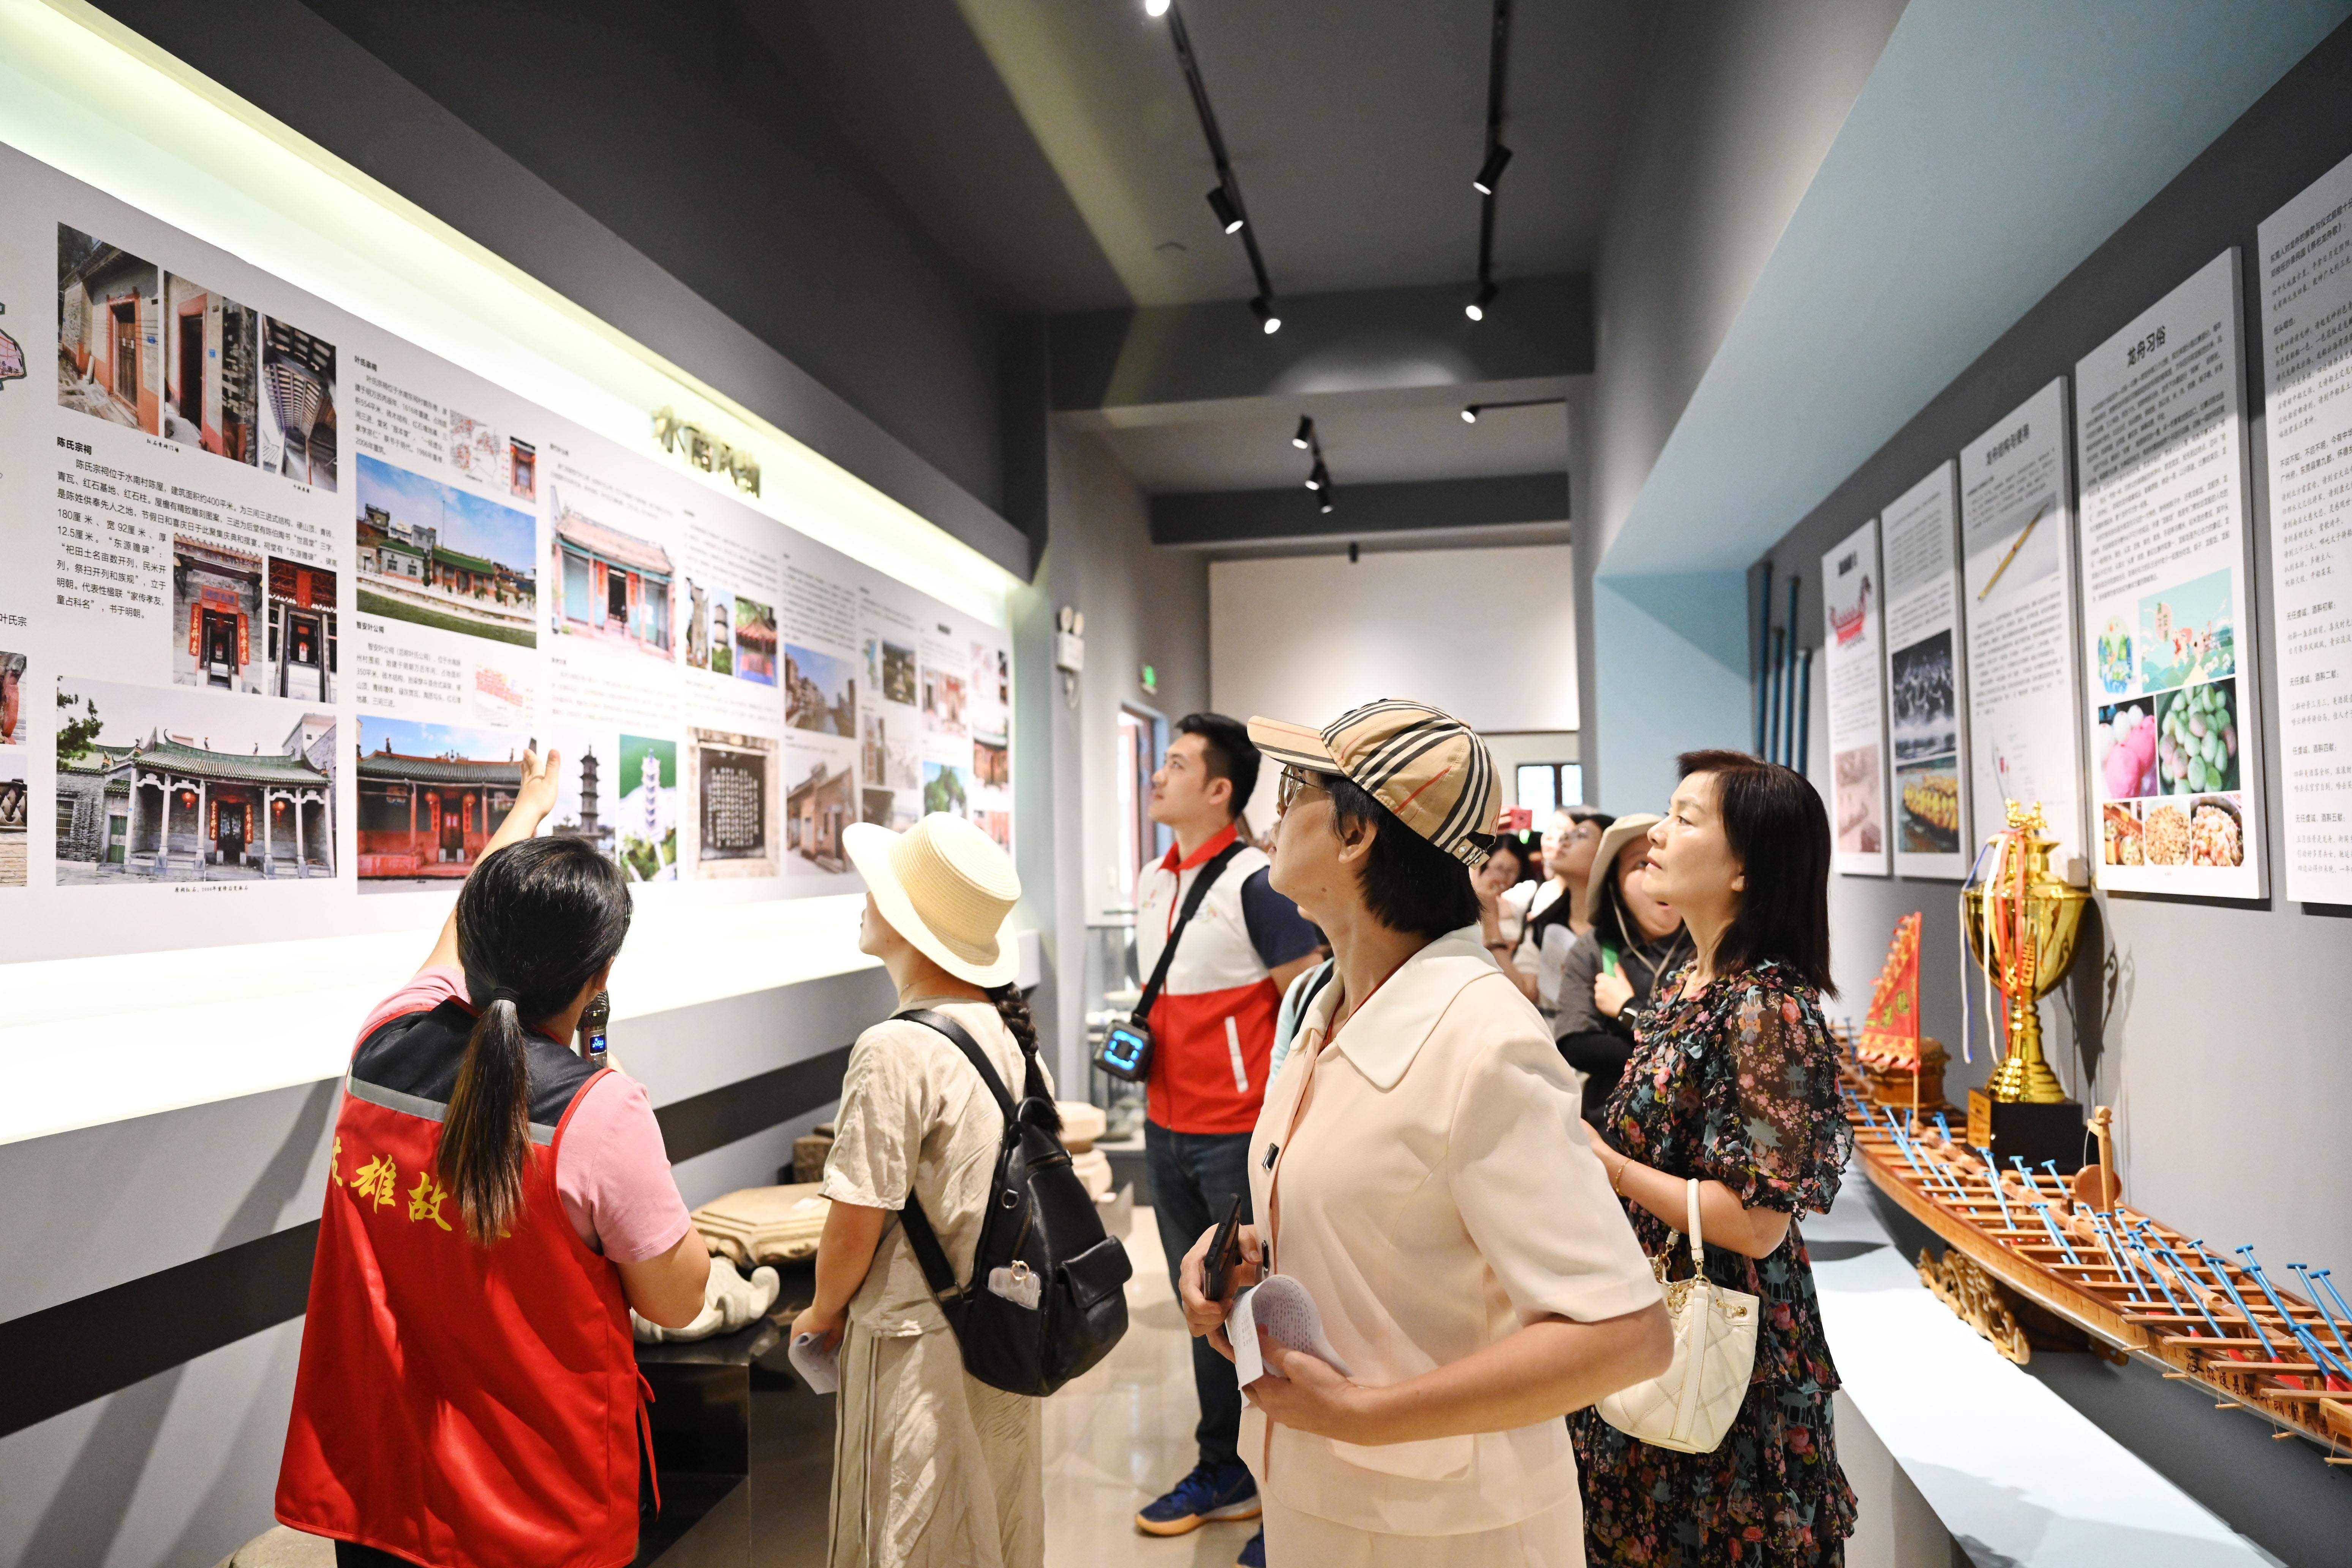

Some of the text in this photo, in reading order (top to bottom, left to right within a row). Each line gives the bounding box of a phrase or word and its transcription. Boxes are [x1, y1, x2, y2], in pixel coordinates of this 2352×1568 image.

[57, 437, 92, 455] 陈氏宗祠
[0, 613, 27, 626] 叶氏宗
[332, 1136, 511, 1238] 雄故
